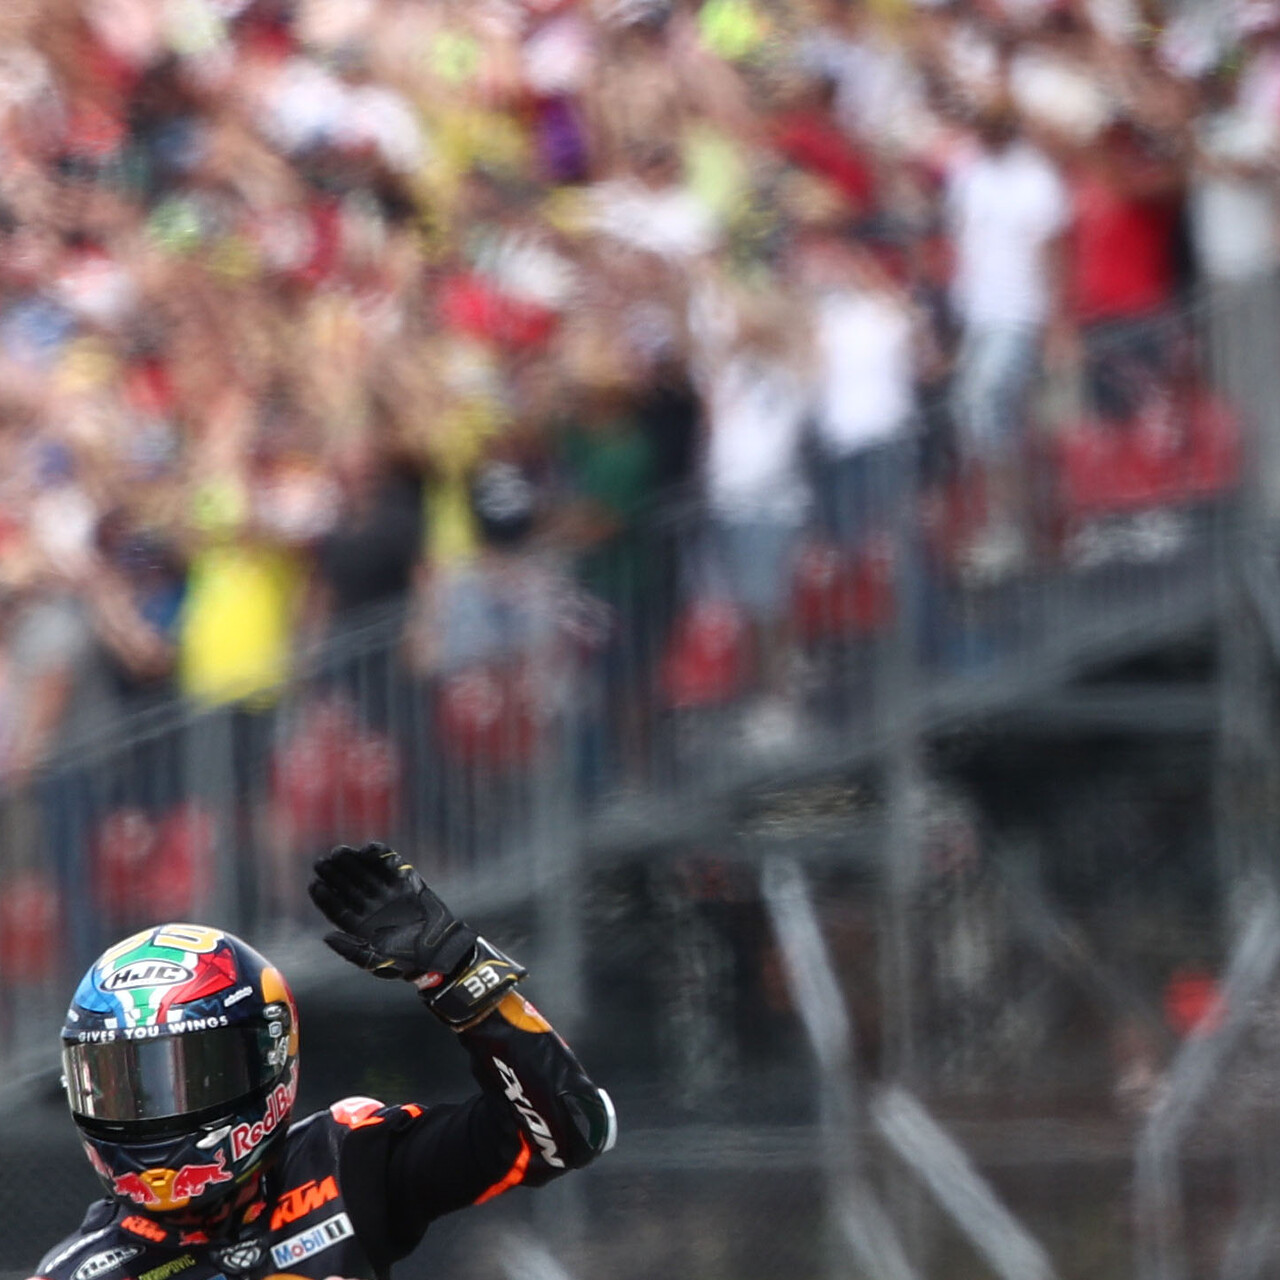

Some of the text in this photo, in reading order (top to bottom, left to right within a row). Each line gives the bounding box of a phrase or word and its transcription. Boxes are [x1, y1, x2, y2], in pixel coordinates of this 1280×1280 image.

[111, 965, 182, 988] HJC
[463, 966, 500, 999] 33
[78, 1015, 229, 1043] GIVES YOU WINGS
[230, 1094, 279, 1162] Red
[271, 1175, 340, 1231] KTM
[275, 1229, 326, 1267] Mobil
[324, 1219, 347, 1241] 1
